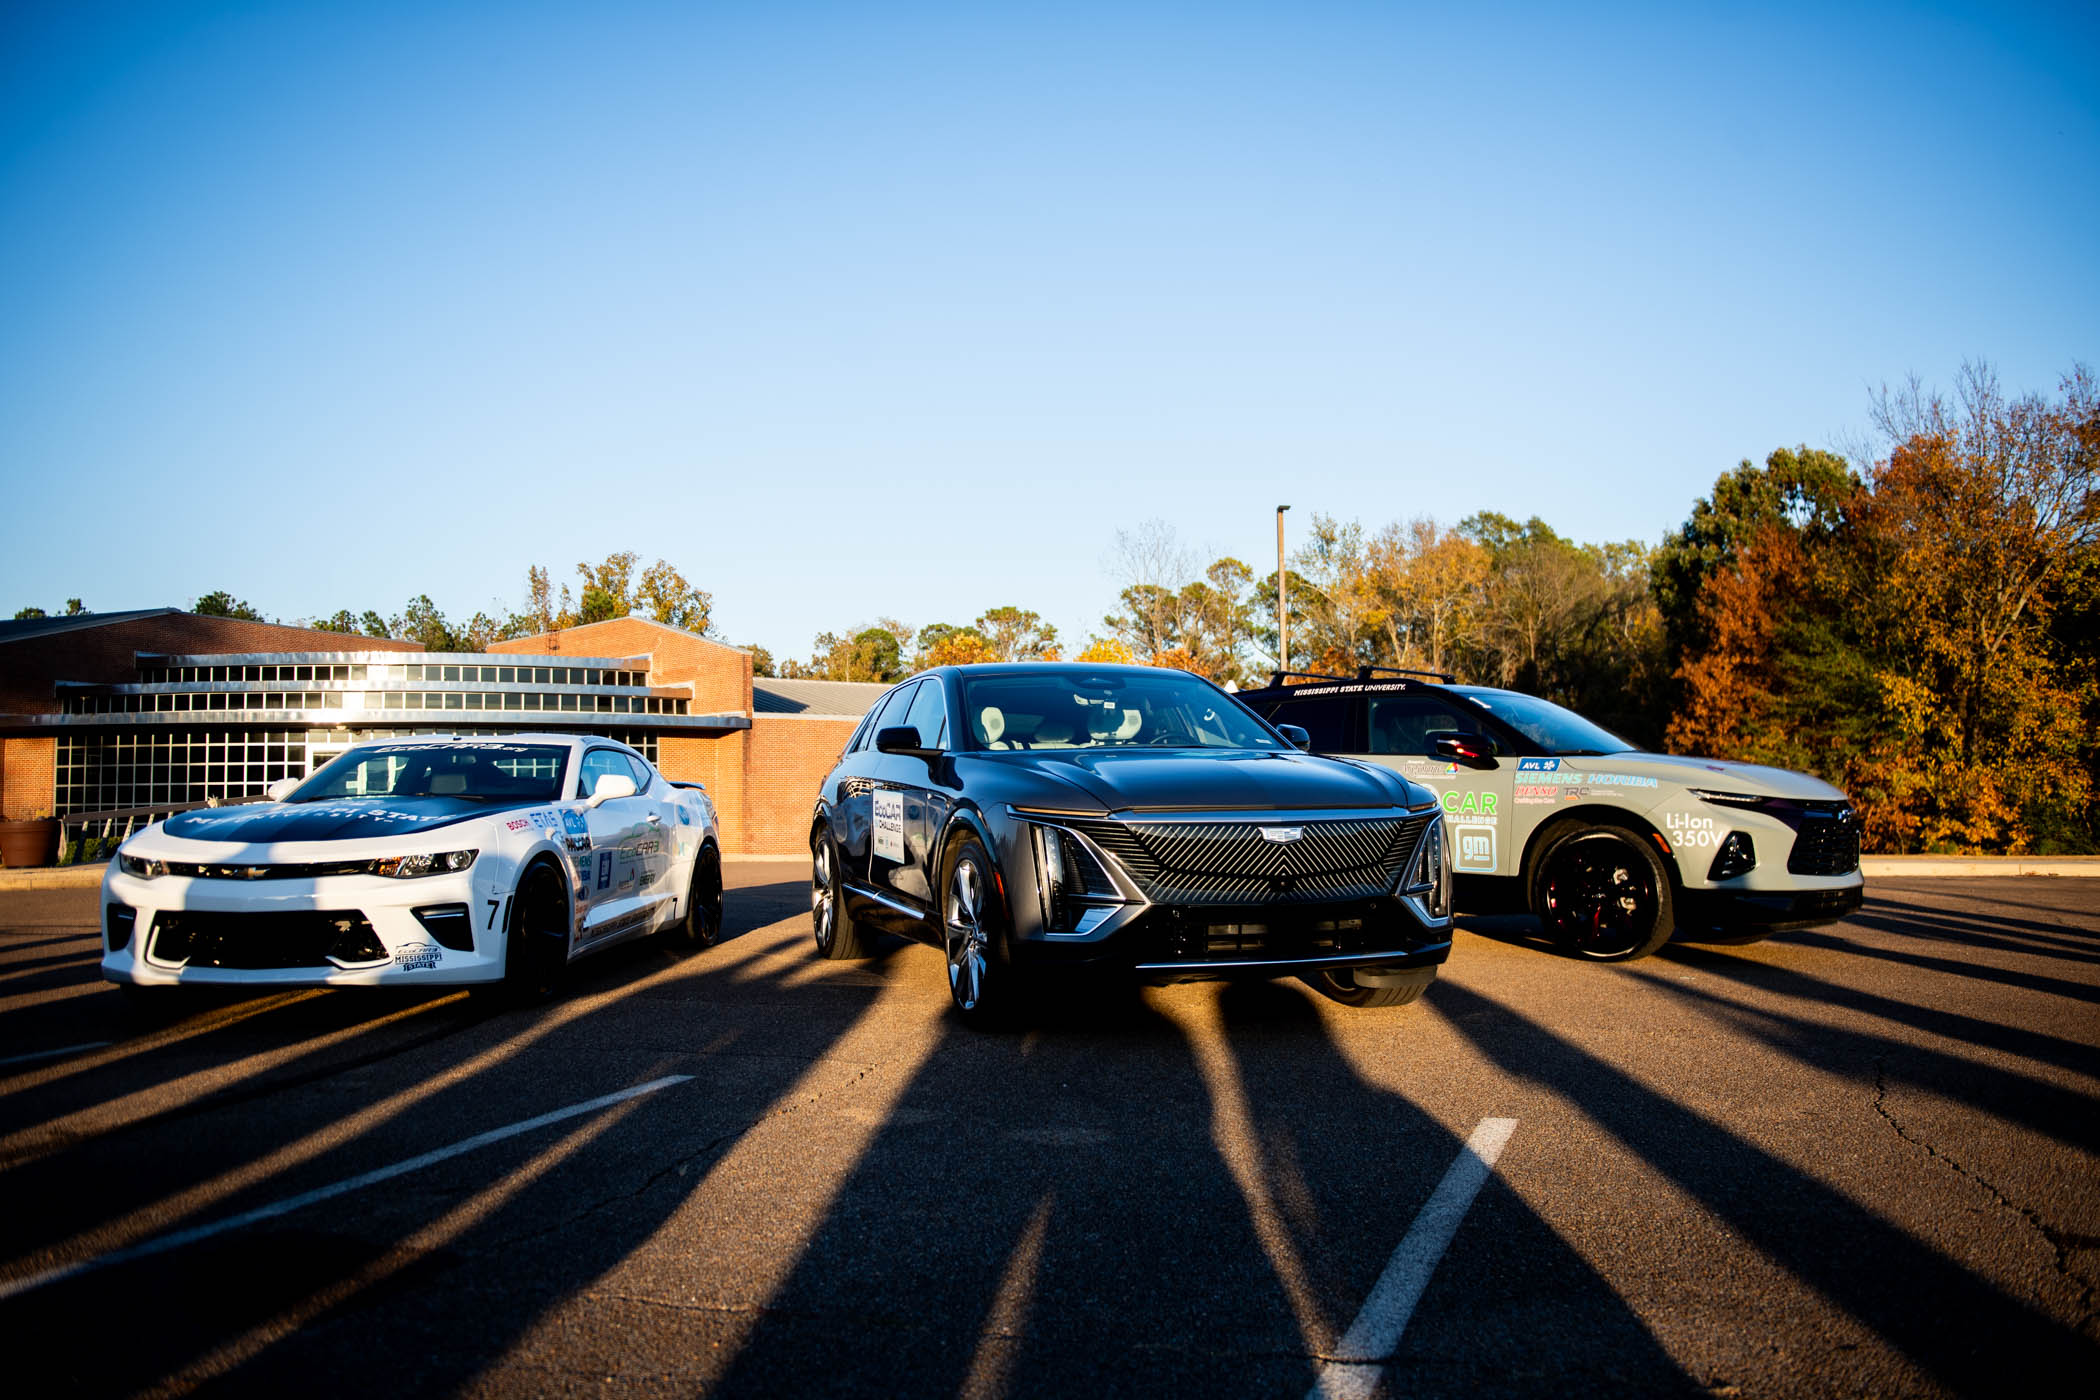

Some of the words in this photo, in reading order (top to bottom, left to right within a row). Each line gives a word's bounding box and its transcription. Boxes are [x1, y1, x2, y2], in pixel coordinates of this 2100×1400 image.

[1294, 686, 1339, 696] MISSISSIPPI
[1340, 685, 1363, 693] STATE
[1522, 761, 1540, 770] AVL
[1515, 772, 1583, 785] SIEMENS
[1587, 773, 1658, 788] HORIBA
[1515, 786, 1558, 797] DENSO
[1563, 787, 1589, 799] TRC
[506, 819, 529, 831] BOSCH
[1672, 830, 1724, 848] 350V
[487, 899, 500, 931] 7
[394, 953, 442, 964] MISSISSIPPI
